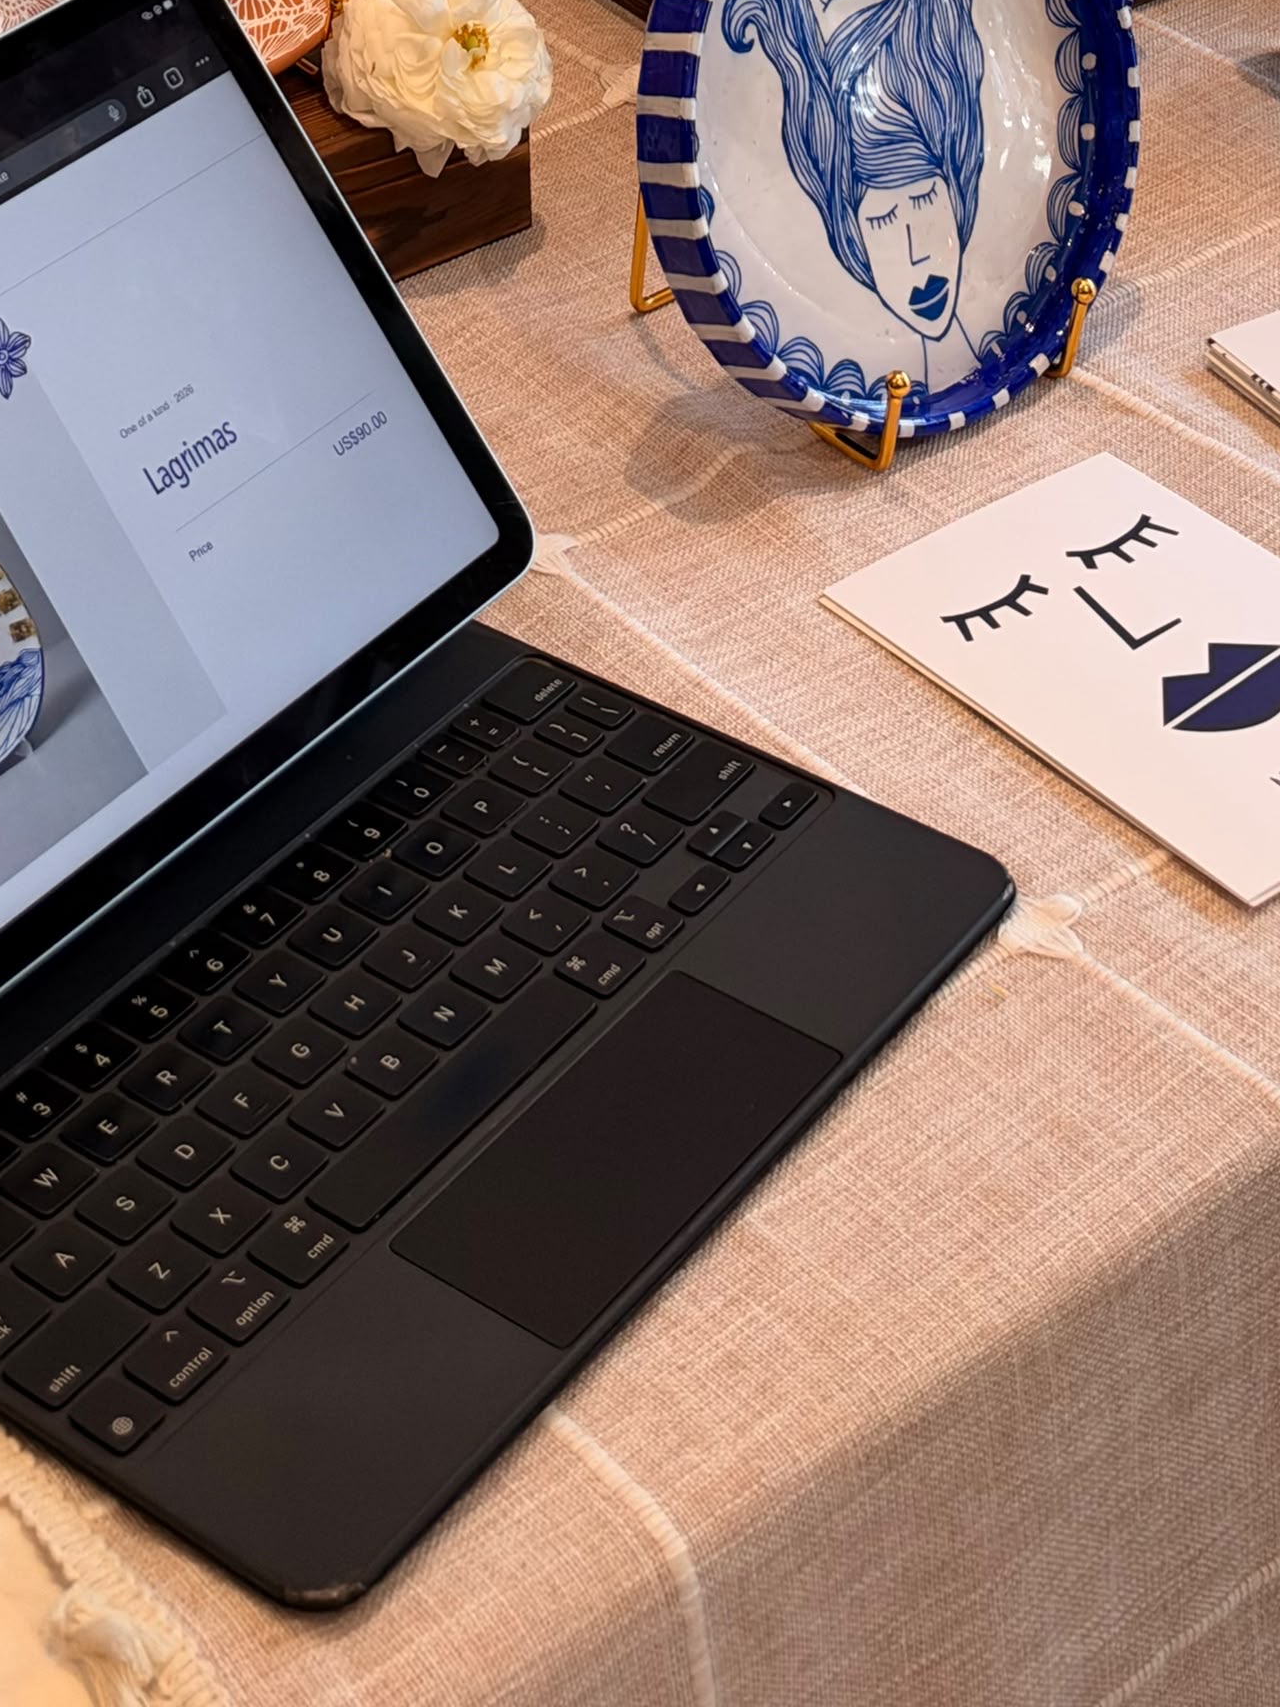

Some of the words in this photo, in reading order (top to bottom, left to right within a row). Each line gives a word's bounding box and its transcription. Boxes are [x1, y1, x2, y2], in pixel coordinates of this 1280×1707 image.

[119, 424, 138, 440] One
[152, 401, 170, 418] kind
[173, 384, 195, 405] 2026
[332, 410, 388, 457] US$90.00
[142, 421, 238, 495] Lagrimas
[189, 541, 214, 562] Price
[535, 679, 562, 701] delete
[653, 734, 680, 756] return
[719, 761, 741, 780] shift
[414, 788, 429, 798] 0
[474, 801, 487, 813] P
[364, 828, 380, 838] 9
[621, 823, 636, 834] ?
[426, 842, 443, 854] O
[314, 871, 330, 882] 8
[499, 866, 516, 874] L
[449, 905, 467, 918] K
[260, 913, 274, 925] 7
[323, 928, 341, 941] U
[646, 923, 664, 938] opt
[403, 950, 415, 962] J
[207, 959, 223, 971] 6
[485, 959, 506, 974] M
[269, 974, 286, 986] Y
[598, 964, 620, 985] cmd
[132, 995, 147, 1005] %
[345, 995, 365, 1010] H
[150, 1005, 168, 1017] 5
[434, 1006, 454, 1021] N
[214, 1021, 231, 1033] T
[292, 1044, 309, 1057] G
[96, 1054, 110, 1066] 4
[381, 1055, 399, 1069] B
[157, 1071, 176, 1085] R
[234, 1093, 248, 1107] F
[33, 1103, 50, 1115] 3
[325, 1103, 344, 1116] V
[99, 1120, 118, 1134] E
[175, 1145, 194, 1159] D
[270, 1156, 288, 1170] C
[34, 1168, 58, 1186] W
[116, 1197, 135, 1210] S
[209, 1208, 231, 1224] X
[308, 1234, 333, 1258] cmd
[56, 1253, 74, 1267] A
[149, 1263, 170, 1279] Z
[236, 1292, 274, 1325] option
[170, 1347, 212, 1387] control
[50, 1365, 80, 1392] shift
